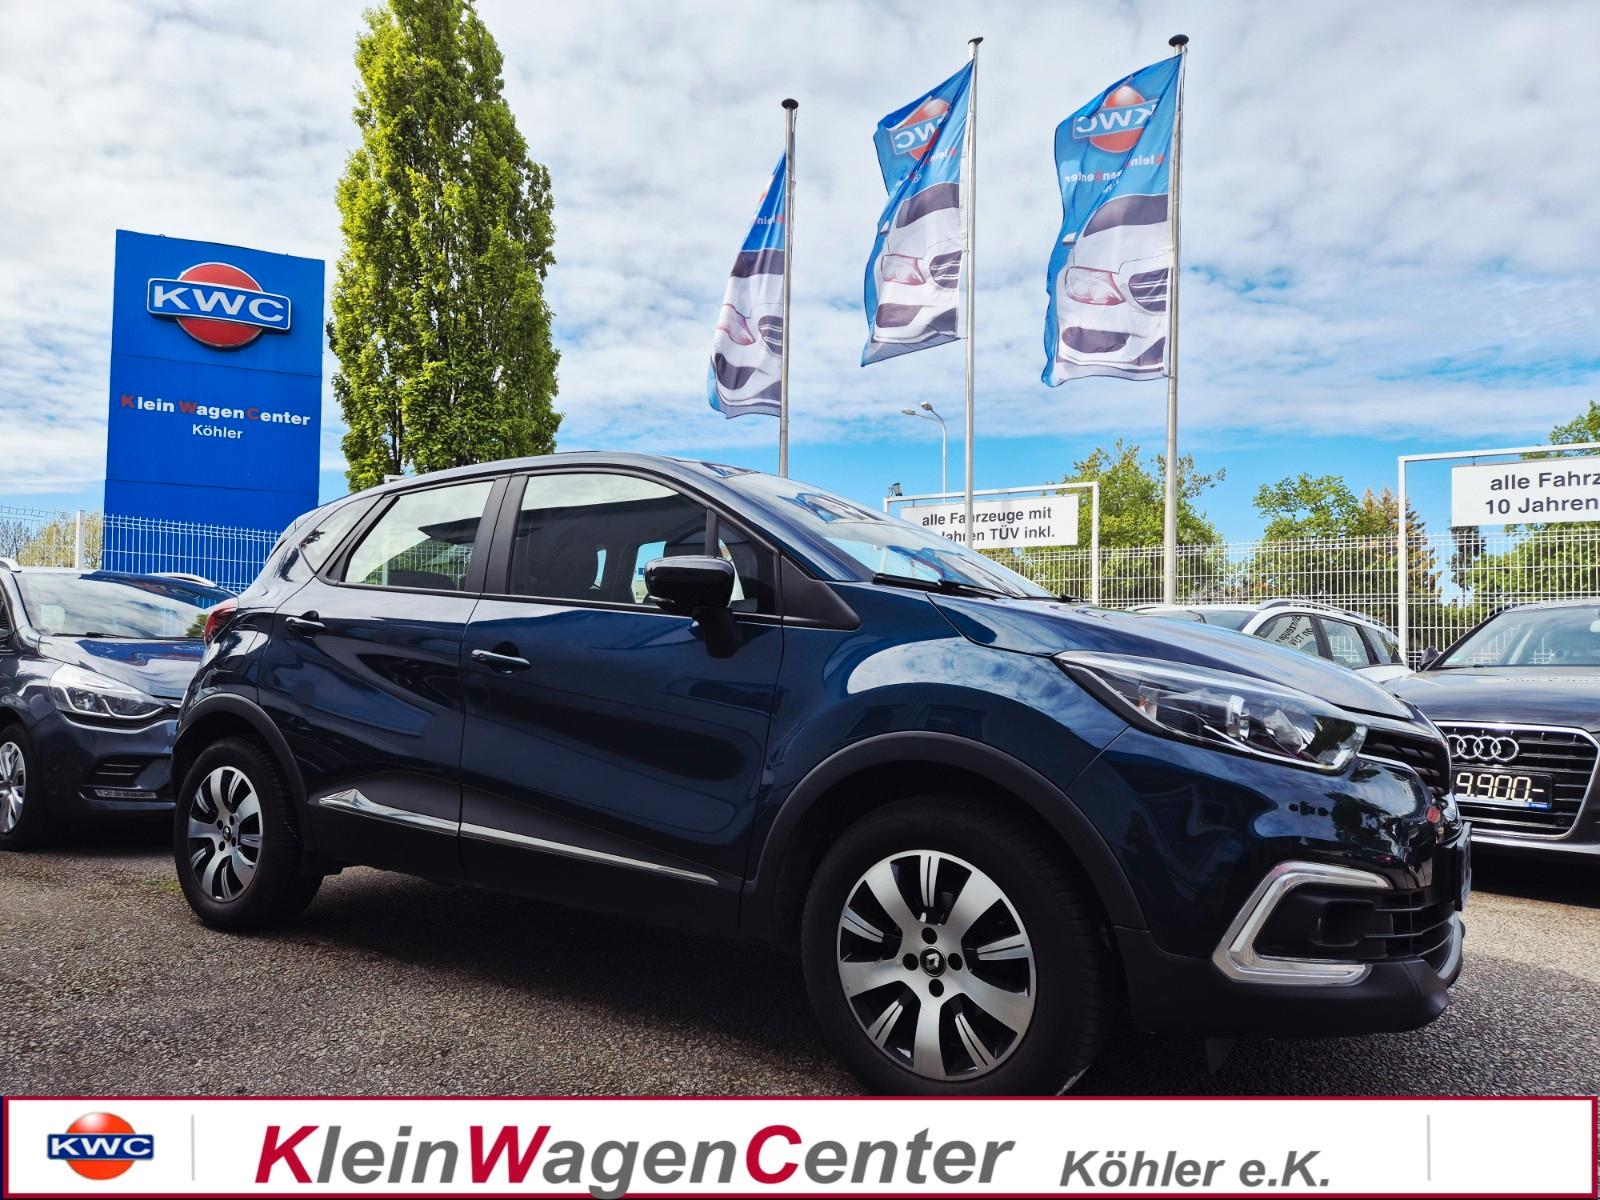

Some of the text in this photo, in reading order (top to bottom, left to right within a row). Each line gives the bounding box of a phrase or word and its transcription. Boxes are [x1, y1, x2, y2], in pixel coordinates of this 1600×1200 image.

[153, 285, 284, 322] KWC
[192, 424, 243, 439] Köhler
[1490, 470, 1600, 491] alle Fahrz
[1485, 497, 1599, 515] 10 Jahren
[922, 506, 1052, 526] alle Farzeuge mit
[989, 524, 1020, 540] TÜV
[1024, 525, 1055, 538] inkl.
